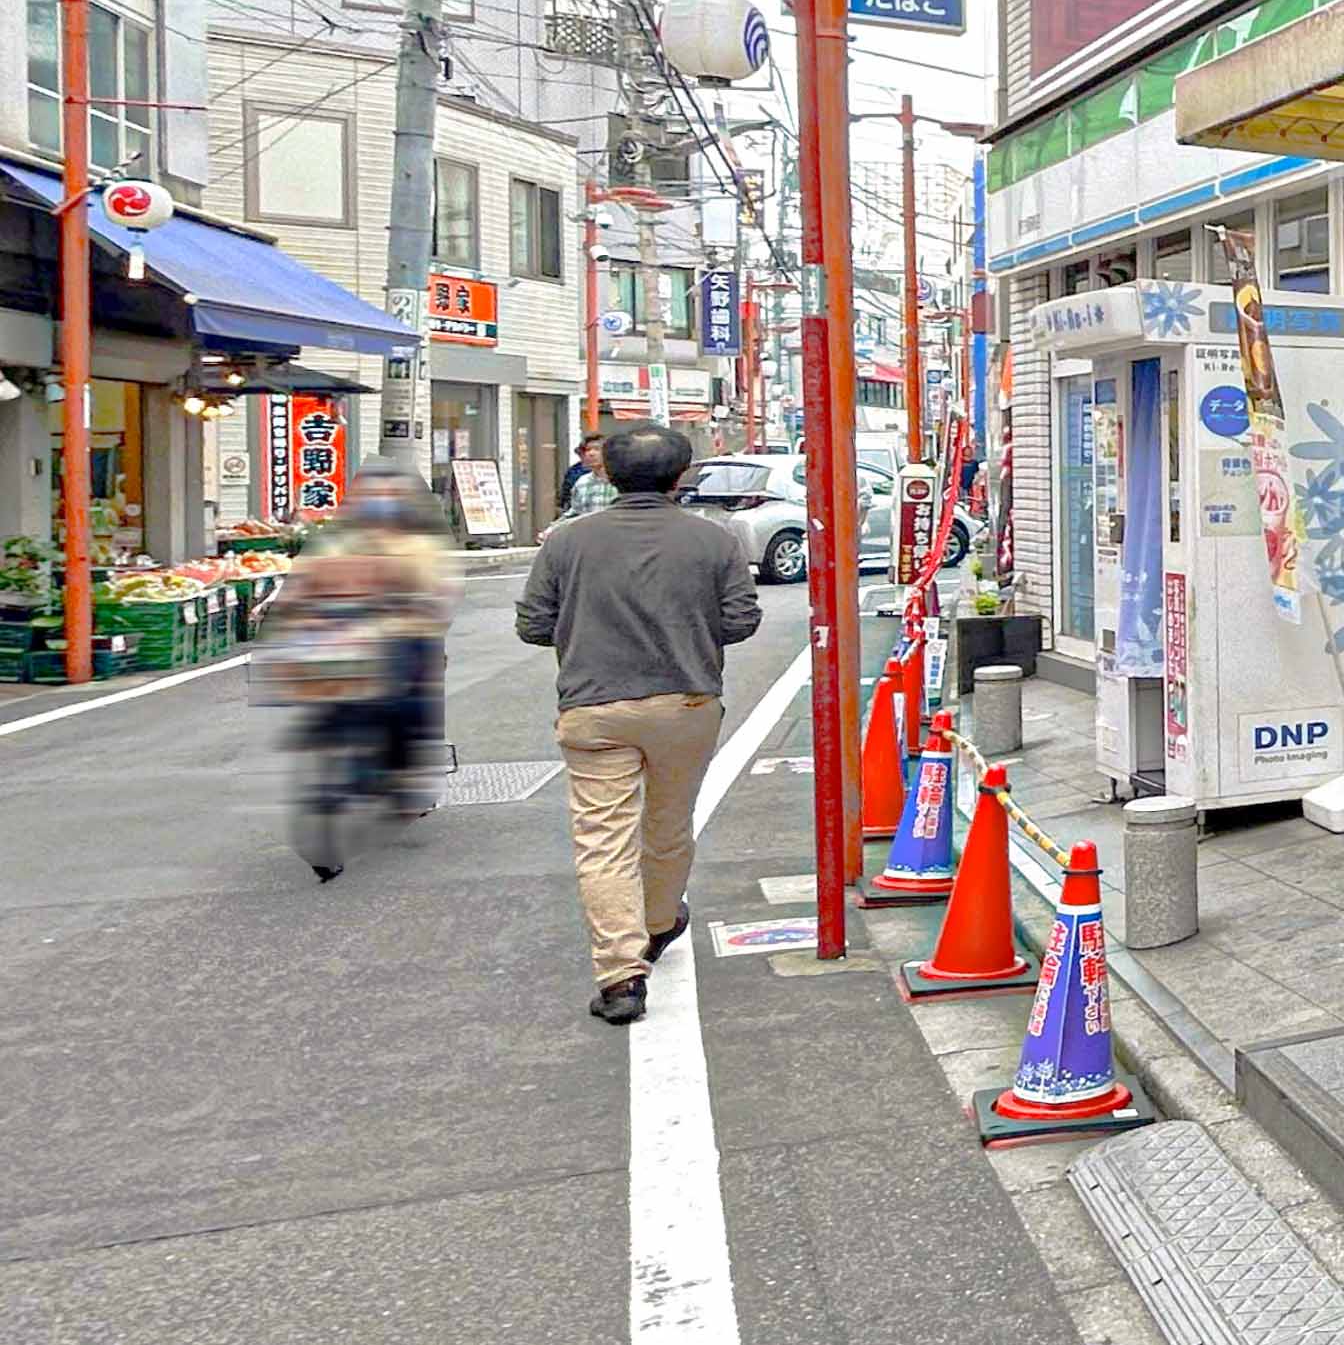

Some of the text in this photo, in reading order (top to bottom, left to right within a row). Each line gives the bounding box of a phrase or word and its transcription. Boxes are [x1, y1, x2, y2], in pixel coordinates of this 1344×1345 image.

[434, 282, 471, 314] 野家
[301, 413, 336, 509] 吉野家
[1253, 721, 1330, 750] DNP
[1253, 748, 1329, 765] Photo Imaging
